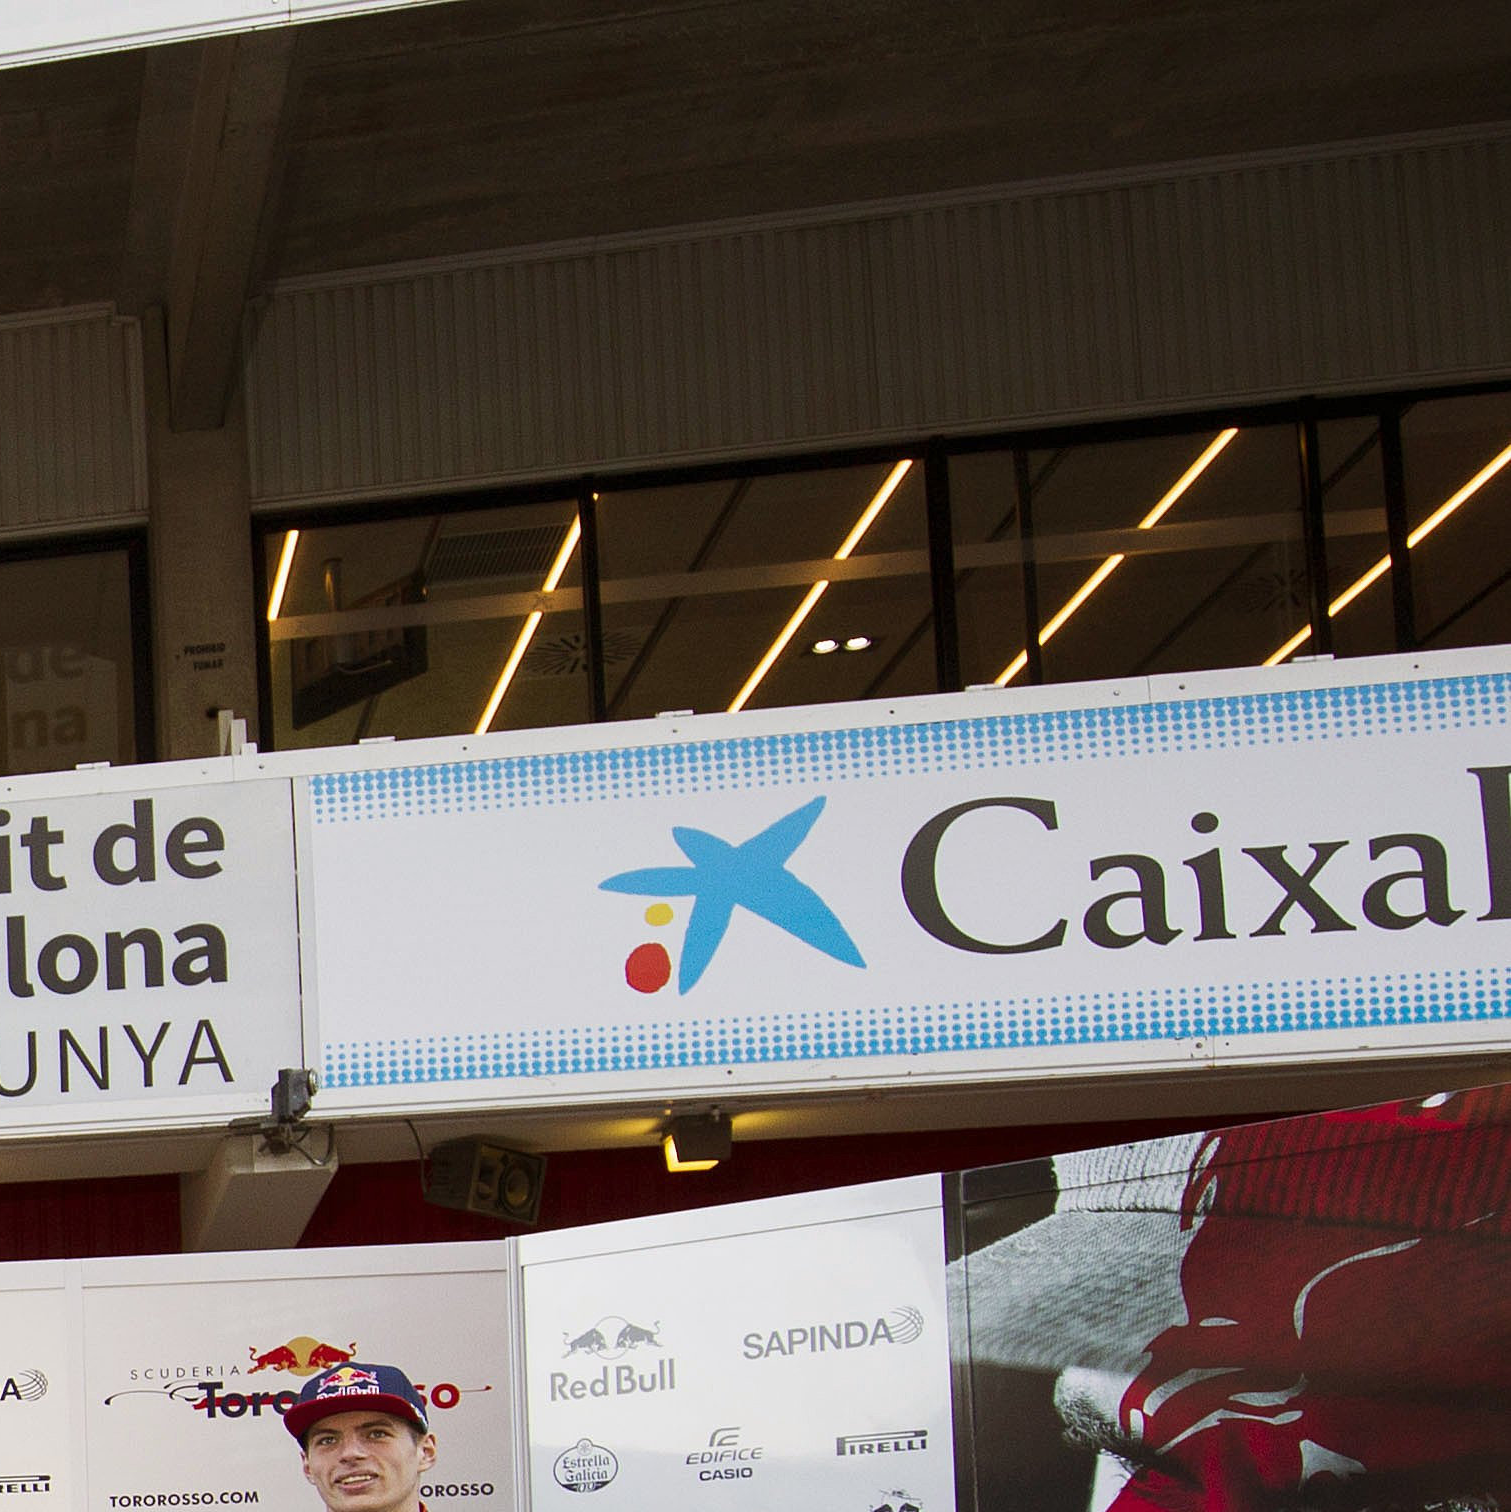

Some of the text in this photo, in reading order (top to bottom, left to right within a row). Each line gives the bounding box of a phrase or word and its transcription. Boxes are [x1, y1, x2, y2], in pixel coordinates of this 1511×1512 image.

[93, 798, 225, 886] de
[743, 1318, 895, 1360] SAPINDA
[130, 1365, 241, 1380] SCUDERIA
[550, 1358, 676, 1401] Red Bull
[198, 1381, 298, 1419] Toro
[836, 1430, 928, 1456] PIRELLI
[563, 1454, 610, 1470] Estrella
[686, 1447, 763, 1466] EDIFICE
[565, 1468, 608, 1483] Galicia
[699, 1467, 753, 1481] CASIO
[110, 1491, 259, 1508] TOROROSSO.COM
[420, 1483, 495, 1498] OROSSO
